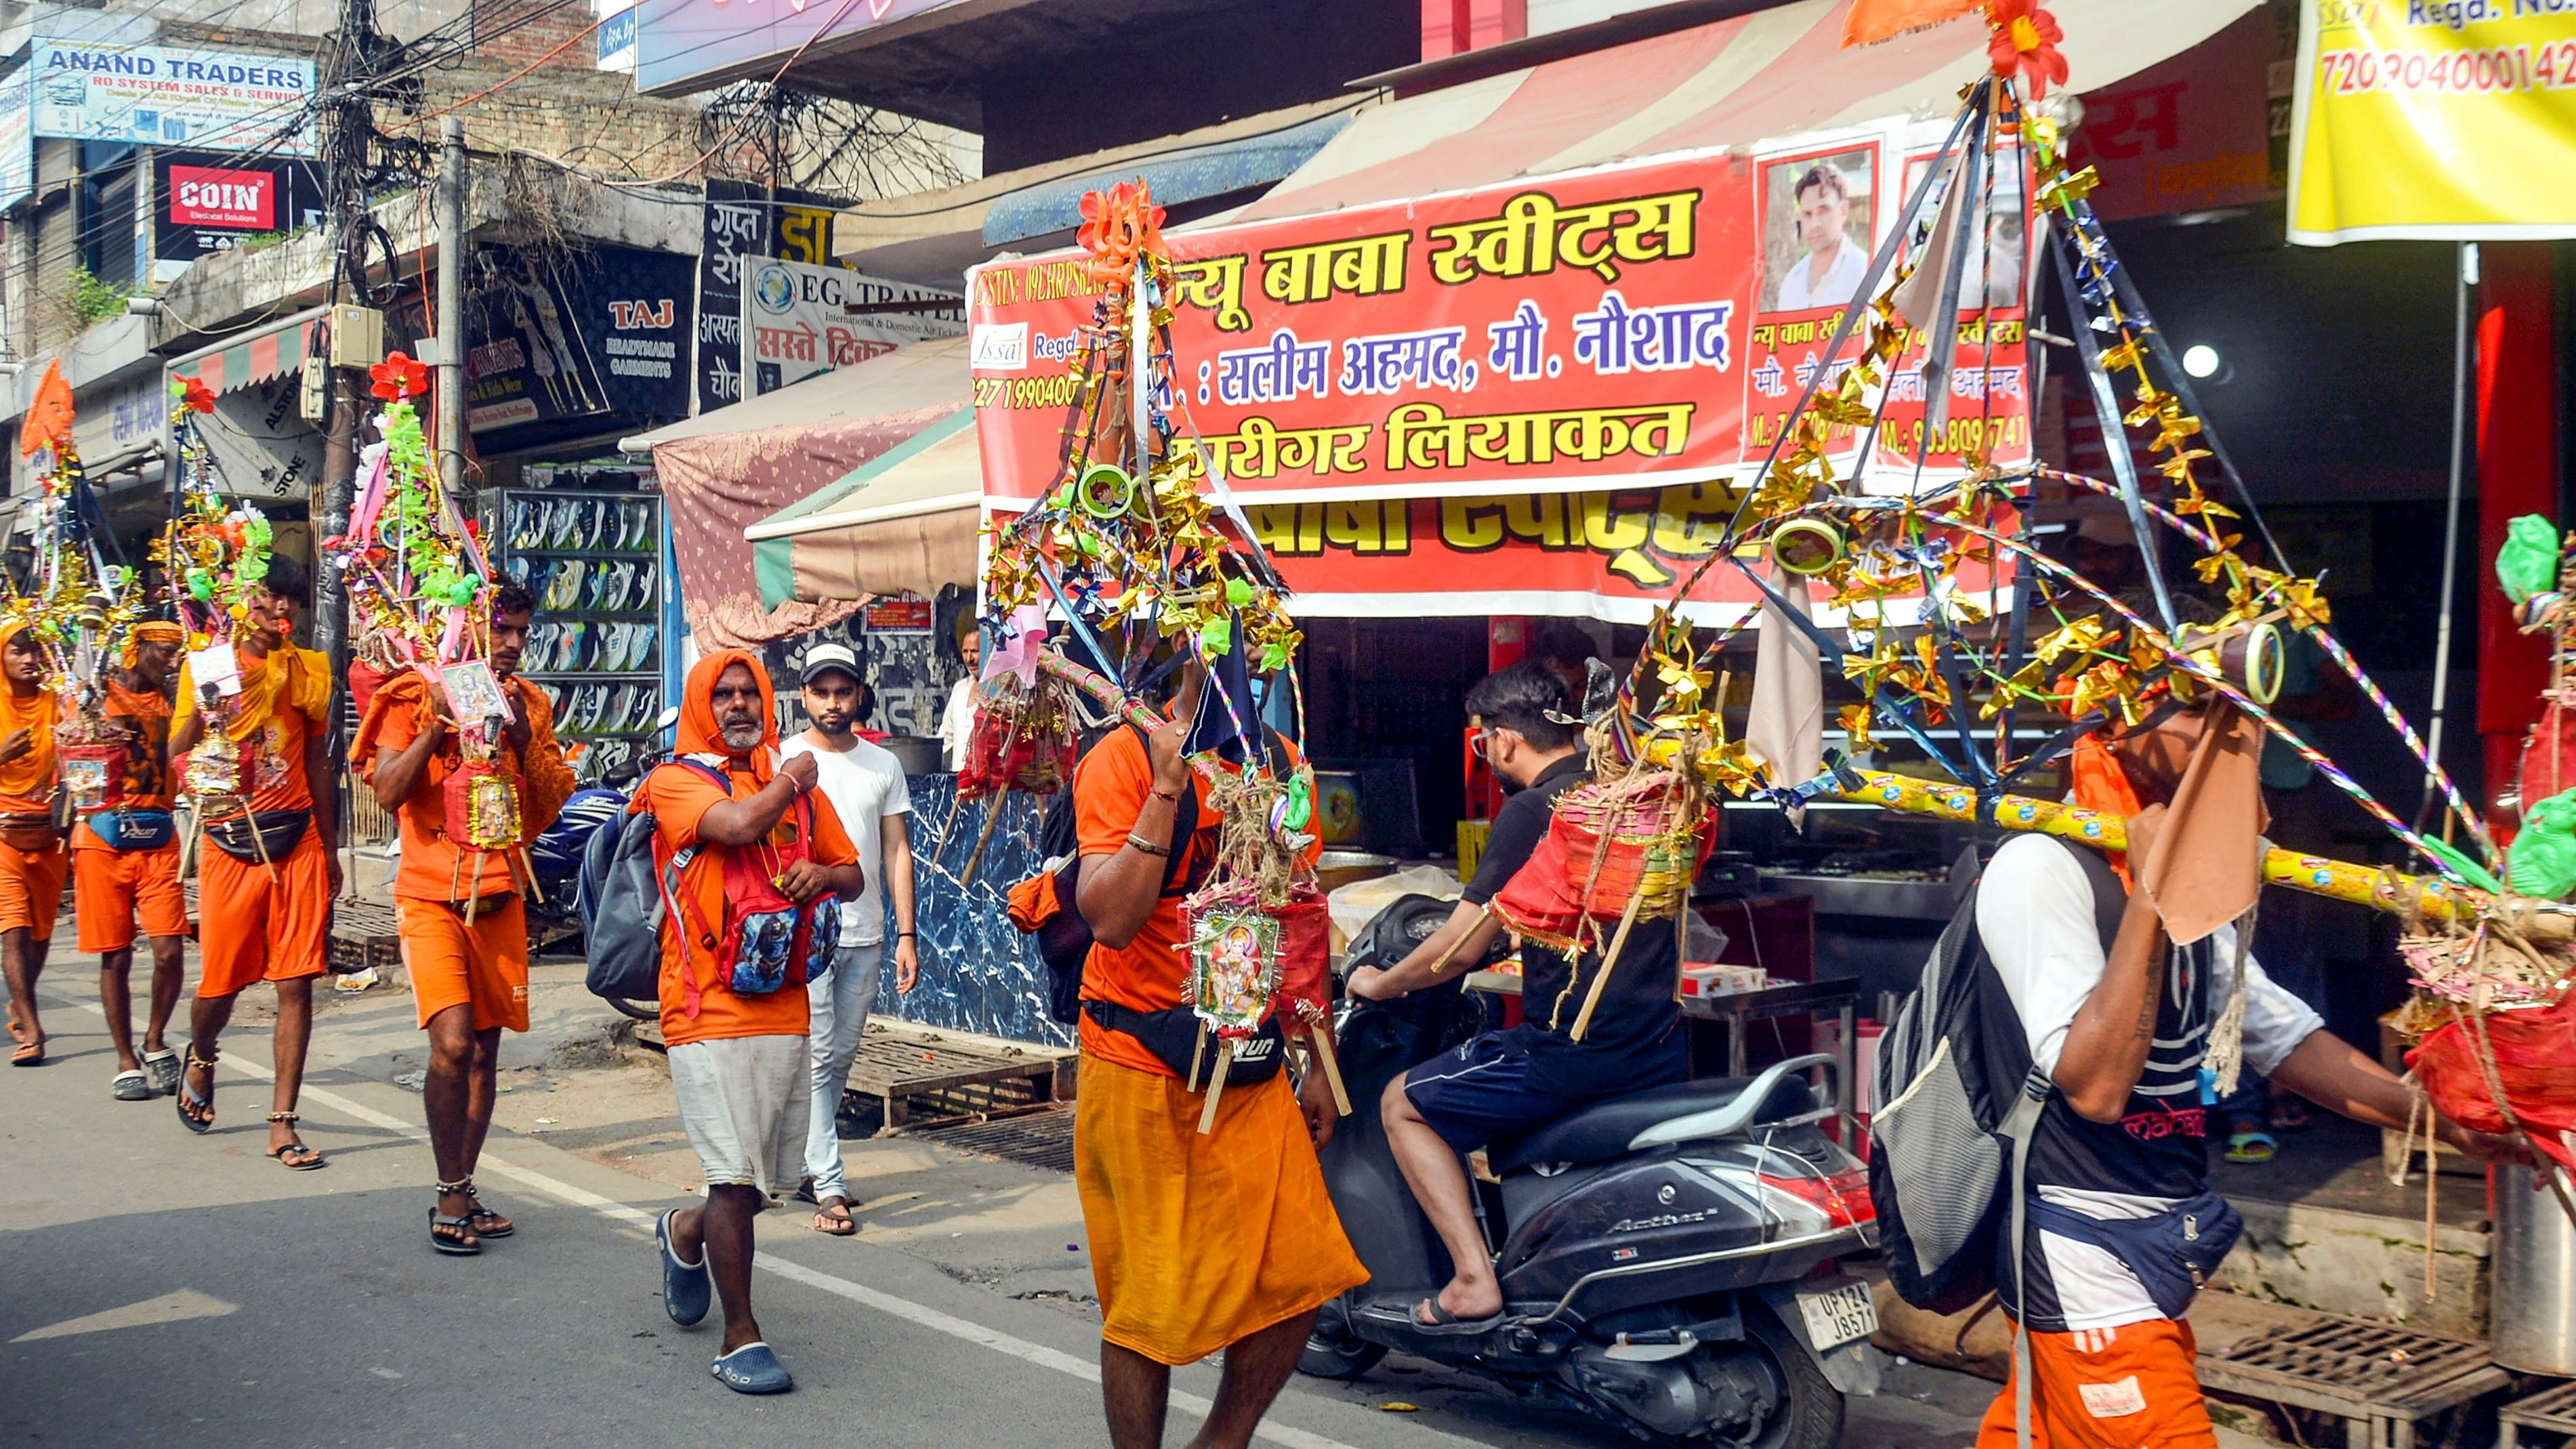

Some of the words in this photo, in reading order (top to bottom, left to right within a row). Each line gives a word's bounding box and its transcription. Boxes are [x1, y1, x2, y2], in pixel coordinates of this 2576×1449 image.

[48, 50, 156, 75] ANAND
[166, 60, 304, 89] TRADERS
[93, 77, 112, 85] RO
[118, 78, 180, 91] SYSTEM
[184, 83, 229, 96] SALES
[180, 181, 259, 211] COIN
[224, 213, 257, 223] Solutions
[711, 204, 762, 248] गुप्त
[1262, 230, 1413, 306] बाबा
[1427, 188, 1703, 285] स्वीट्स
[711, 248, 741, 285] रो
[976, 268, 1020, 306] GSTIN:
[608, 299, 674, 330] TAJ
[825, 311, 875, 329] International
[875, 320, 884, 328] &
[885, 320, 921, 335] Domestic
[923, 324, 936, 335] Air
[470, 337, 526, 378] RMENTS
[606, 337, 676, 359] READYMADE
[755, 320, 818, 363] सस्ते
[1220, 329, 1330, 404] सलीम
[1339, 328, 1478, 394] अहमद,
[1489, 300, 1561, 379] मौ.
[1575, 291, 1732, 372] नौशाद
[610, 358, 671, 379] GARMENTS
[973, 375, 1079, 410] 271990400
[1384, 401, 1697, 472] लियाकत
[274, 455, 306, 497] STONE
